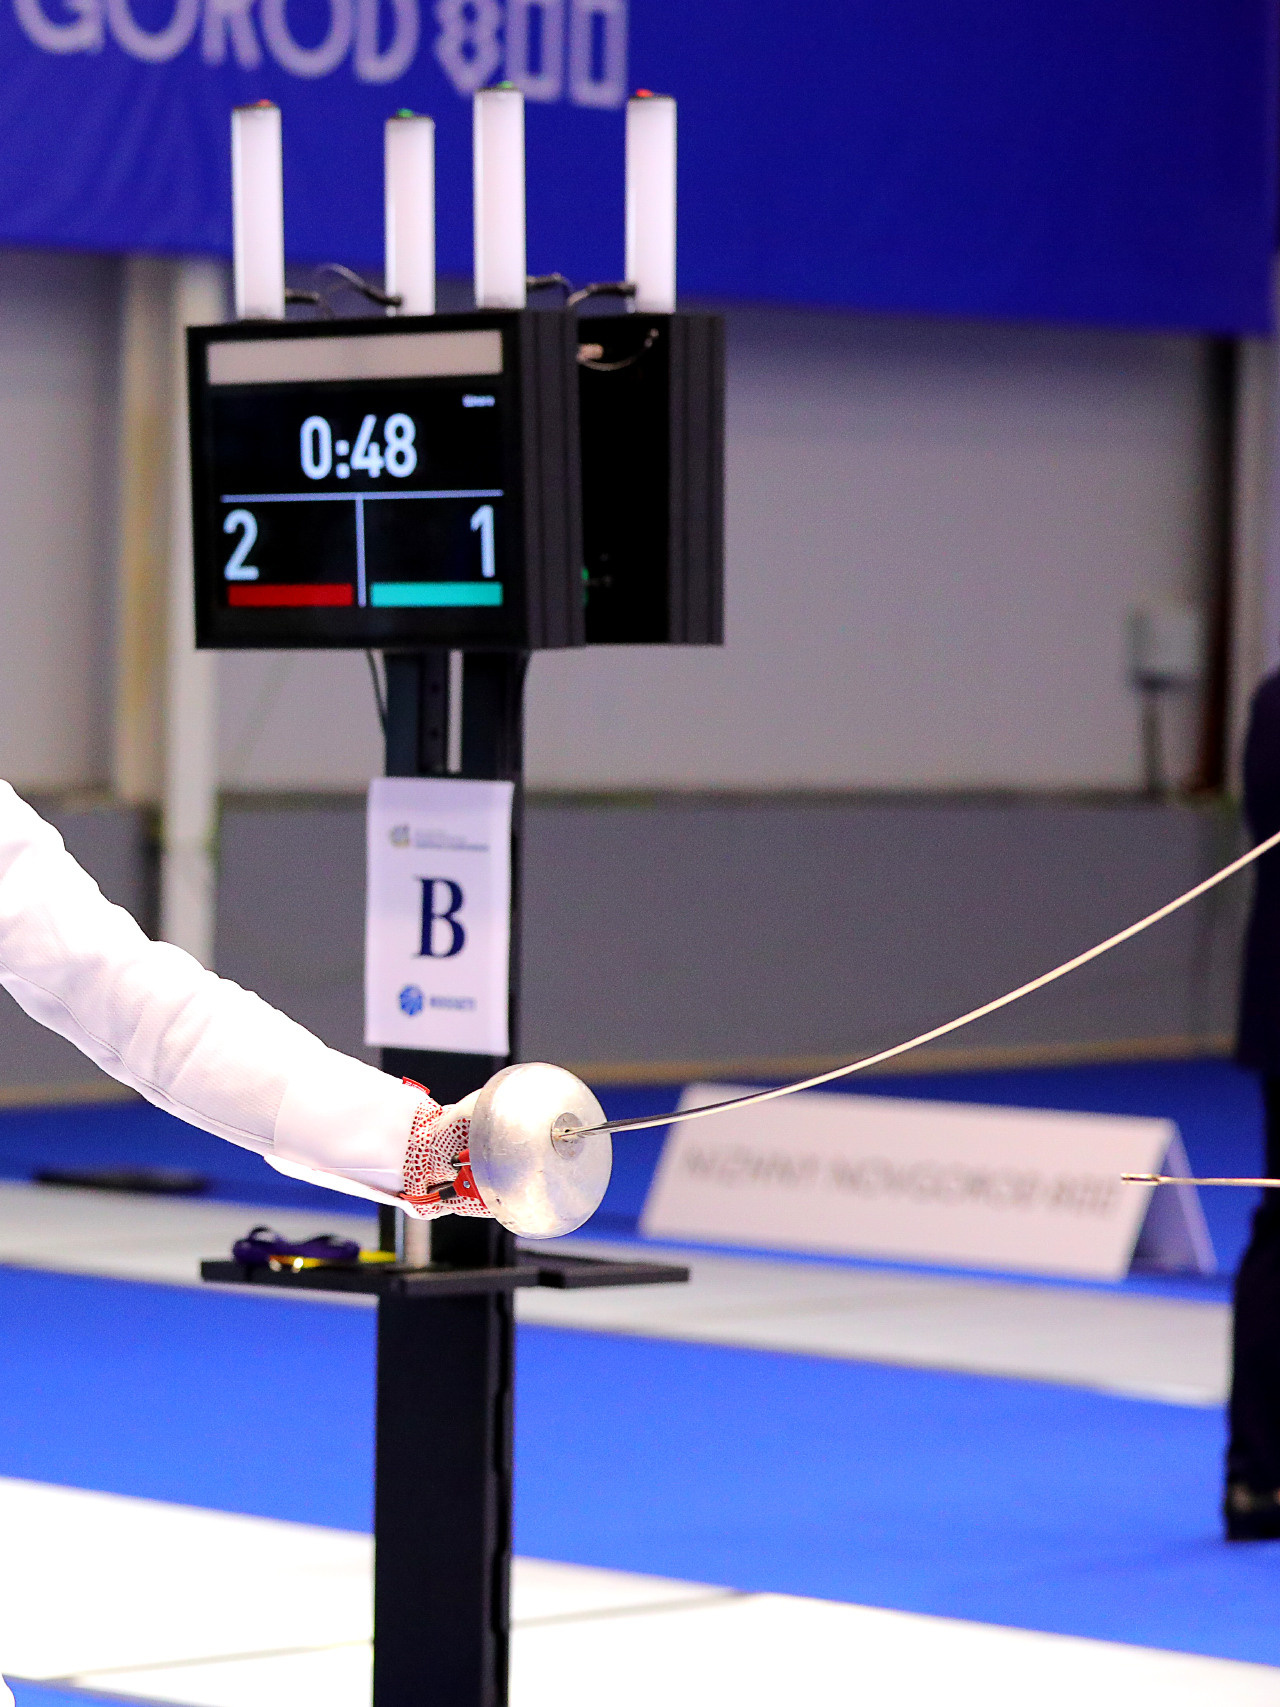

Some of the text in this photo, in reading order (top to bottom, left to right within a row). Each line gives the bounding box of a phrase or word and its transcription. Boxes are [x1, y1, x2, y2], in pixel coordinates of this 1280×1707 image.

[300, 413, 417, 479] 0:48
[223, 508, 259, 580] 2
[470, 505, 495, 577] 1
[413, 876, 466, 958] B
